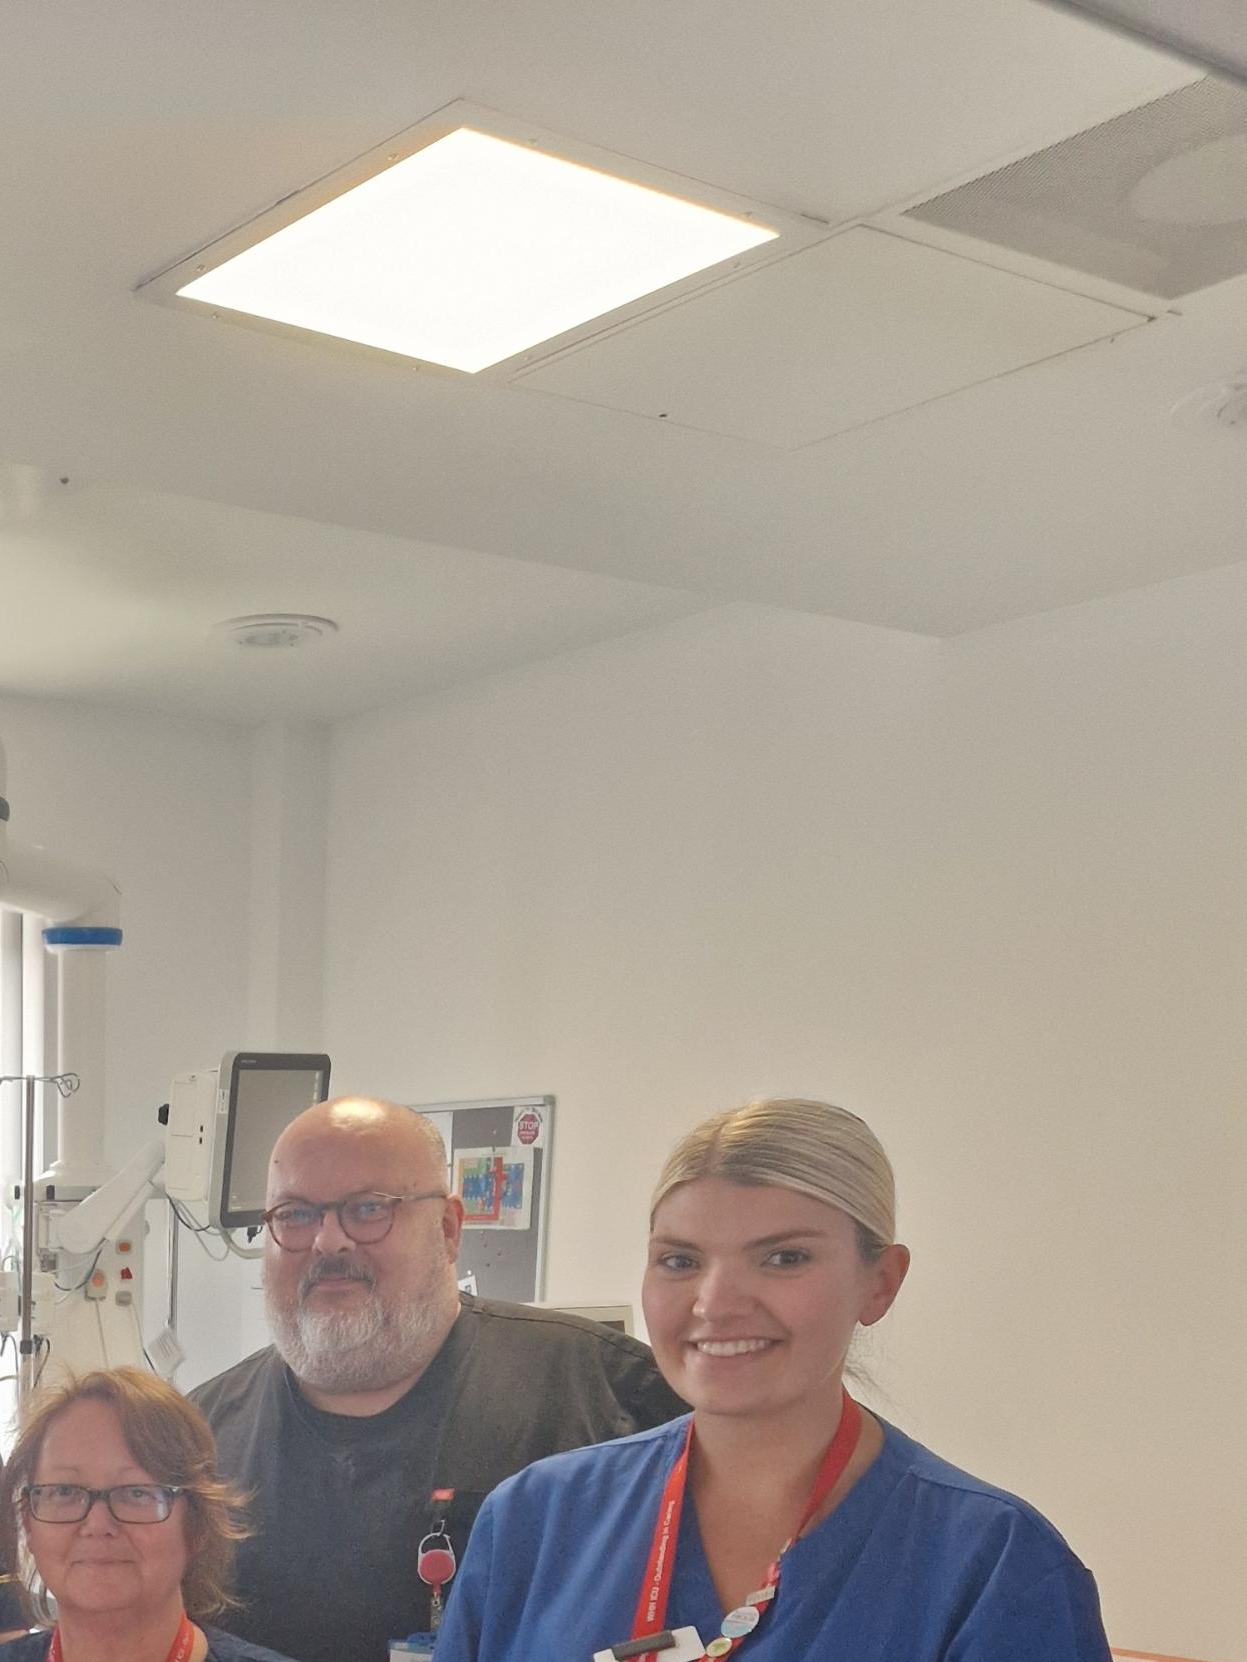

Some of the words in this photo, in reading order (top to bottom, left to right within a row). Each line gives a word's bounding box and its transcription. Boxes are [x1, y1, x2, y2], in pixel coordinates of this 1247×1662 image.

[520, 1121, 538, 1130] STOP
[663, 1499, 675, 1525] Caring
[653, 1534, 669, 1581] Outstanding
[650, 1586, 659, 1600] ICU
